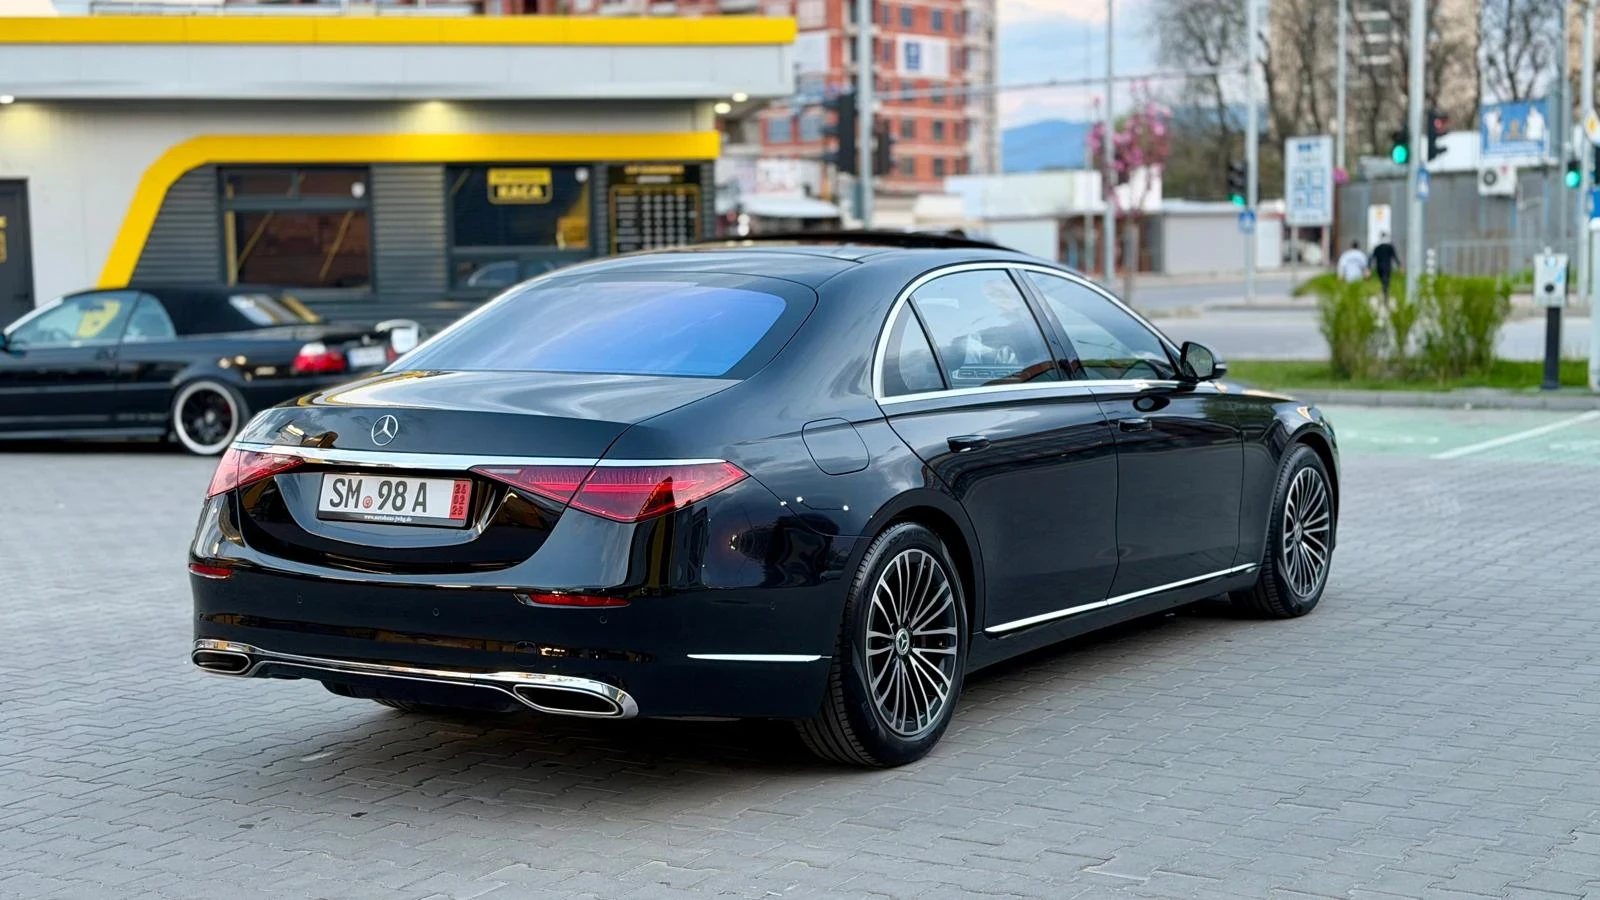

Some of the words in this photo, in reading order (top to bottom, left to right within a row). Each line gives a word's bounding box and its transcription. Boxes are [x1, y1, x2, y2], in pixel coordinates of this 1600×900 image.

[329, 478, 363, 508] SM
[377, 480, 408, 511] 98
[411, 482, 427, 513] A
[453, 494, 465, 505] 02
[451, 505, 464, 516] 25
